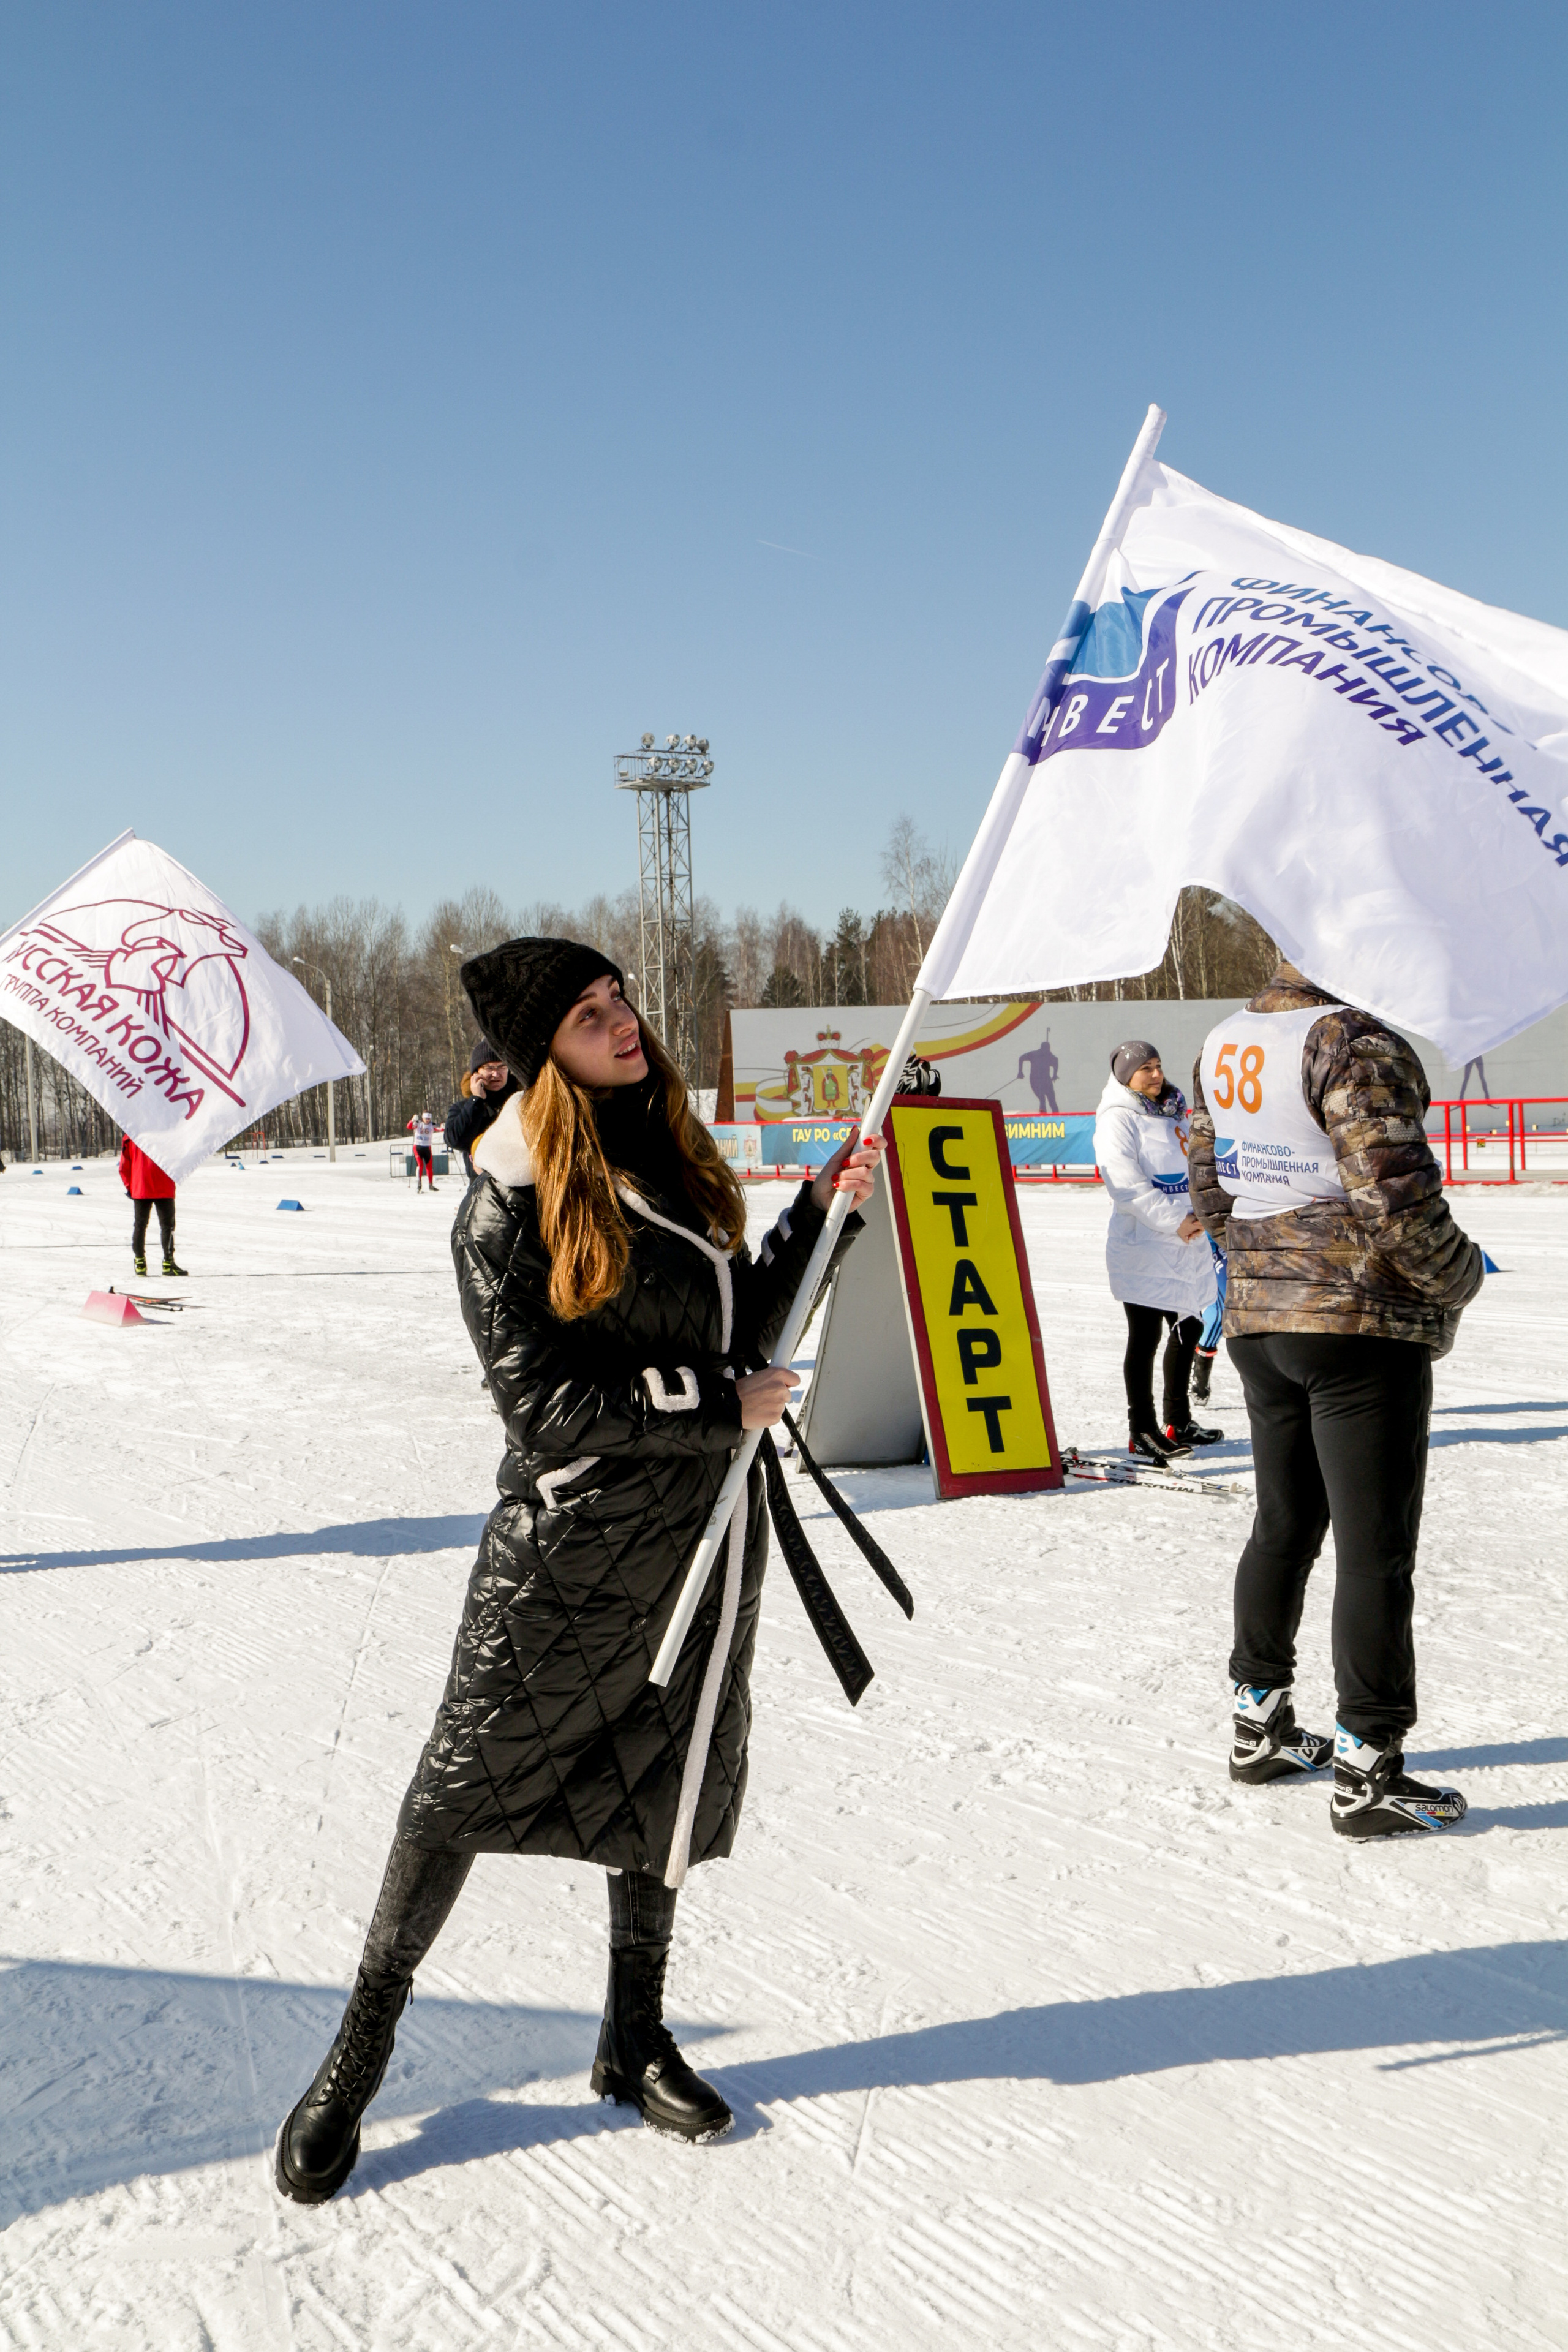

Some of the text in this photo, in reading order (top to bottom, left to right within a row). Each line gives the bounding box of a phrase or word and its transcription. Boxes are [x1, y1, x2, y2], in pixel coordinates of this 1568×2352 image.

[1188, 633, 1428, 746] КОМПАНИЯ
[1191, 597, 1568, 868] ПРОМЫШЛЕННАЯ
[0, 973, 145, 1099] ГРУППА КОМПАНИЙ
[105, 1014, 205, 1120] КОЖА
[1213, 1043, 1265, 1114] 58
[792, 1128, 812, 1143] ГАУ
[815, 1127, 831, 1142] РО
[1241, 1140, 1296, 1158] ФИНАНСОВО-
[1241, 1155, 1319, 1174] ПРОМЫШЛЕННАЯ
[1157, 1184, 1188, 1193] НВЕСТ
[1241, 1169, 1291, 1186] КОМПАНИЯ
[927, 1125, 1013, 1453] СТАРТ
